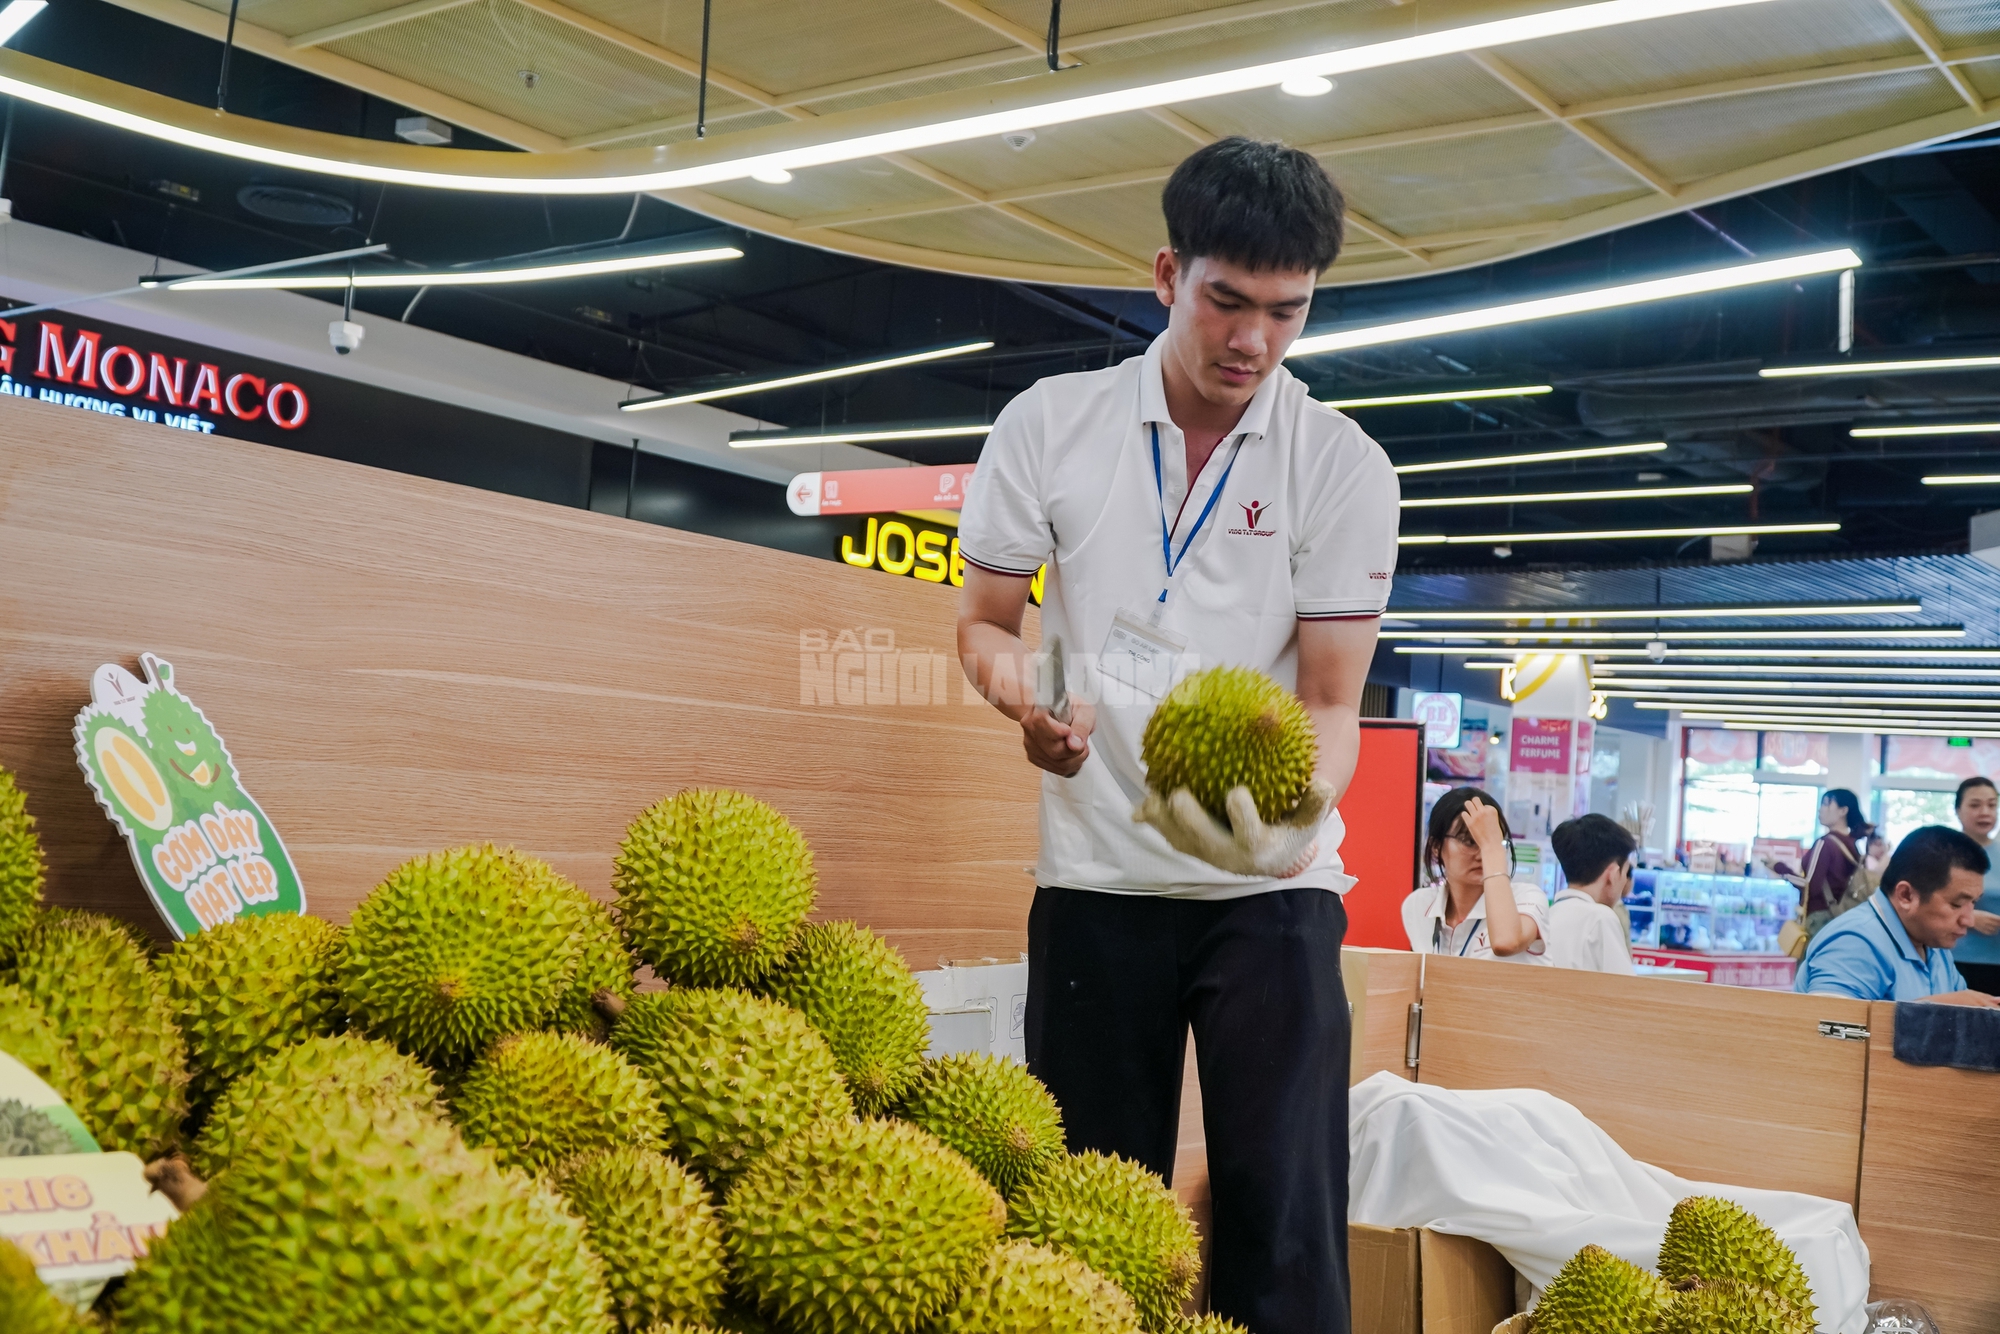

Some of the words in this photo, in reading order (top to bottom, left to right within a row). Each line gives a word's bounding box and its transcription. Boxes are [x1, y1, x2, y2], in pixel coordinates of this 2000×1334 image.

[34, 321, 309, 430] MONACO
[157, 826, 212, 884] CƠM
[205, 807, 258, 852] DÀY
[231, 852, 273, 898] LÉP
